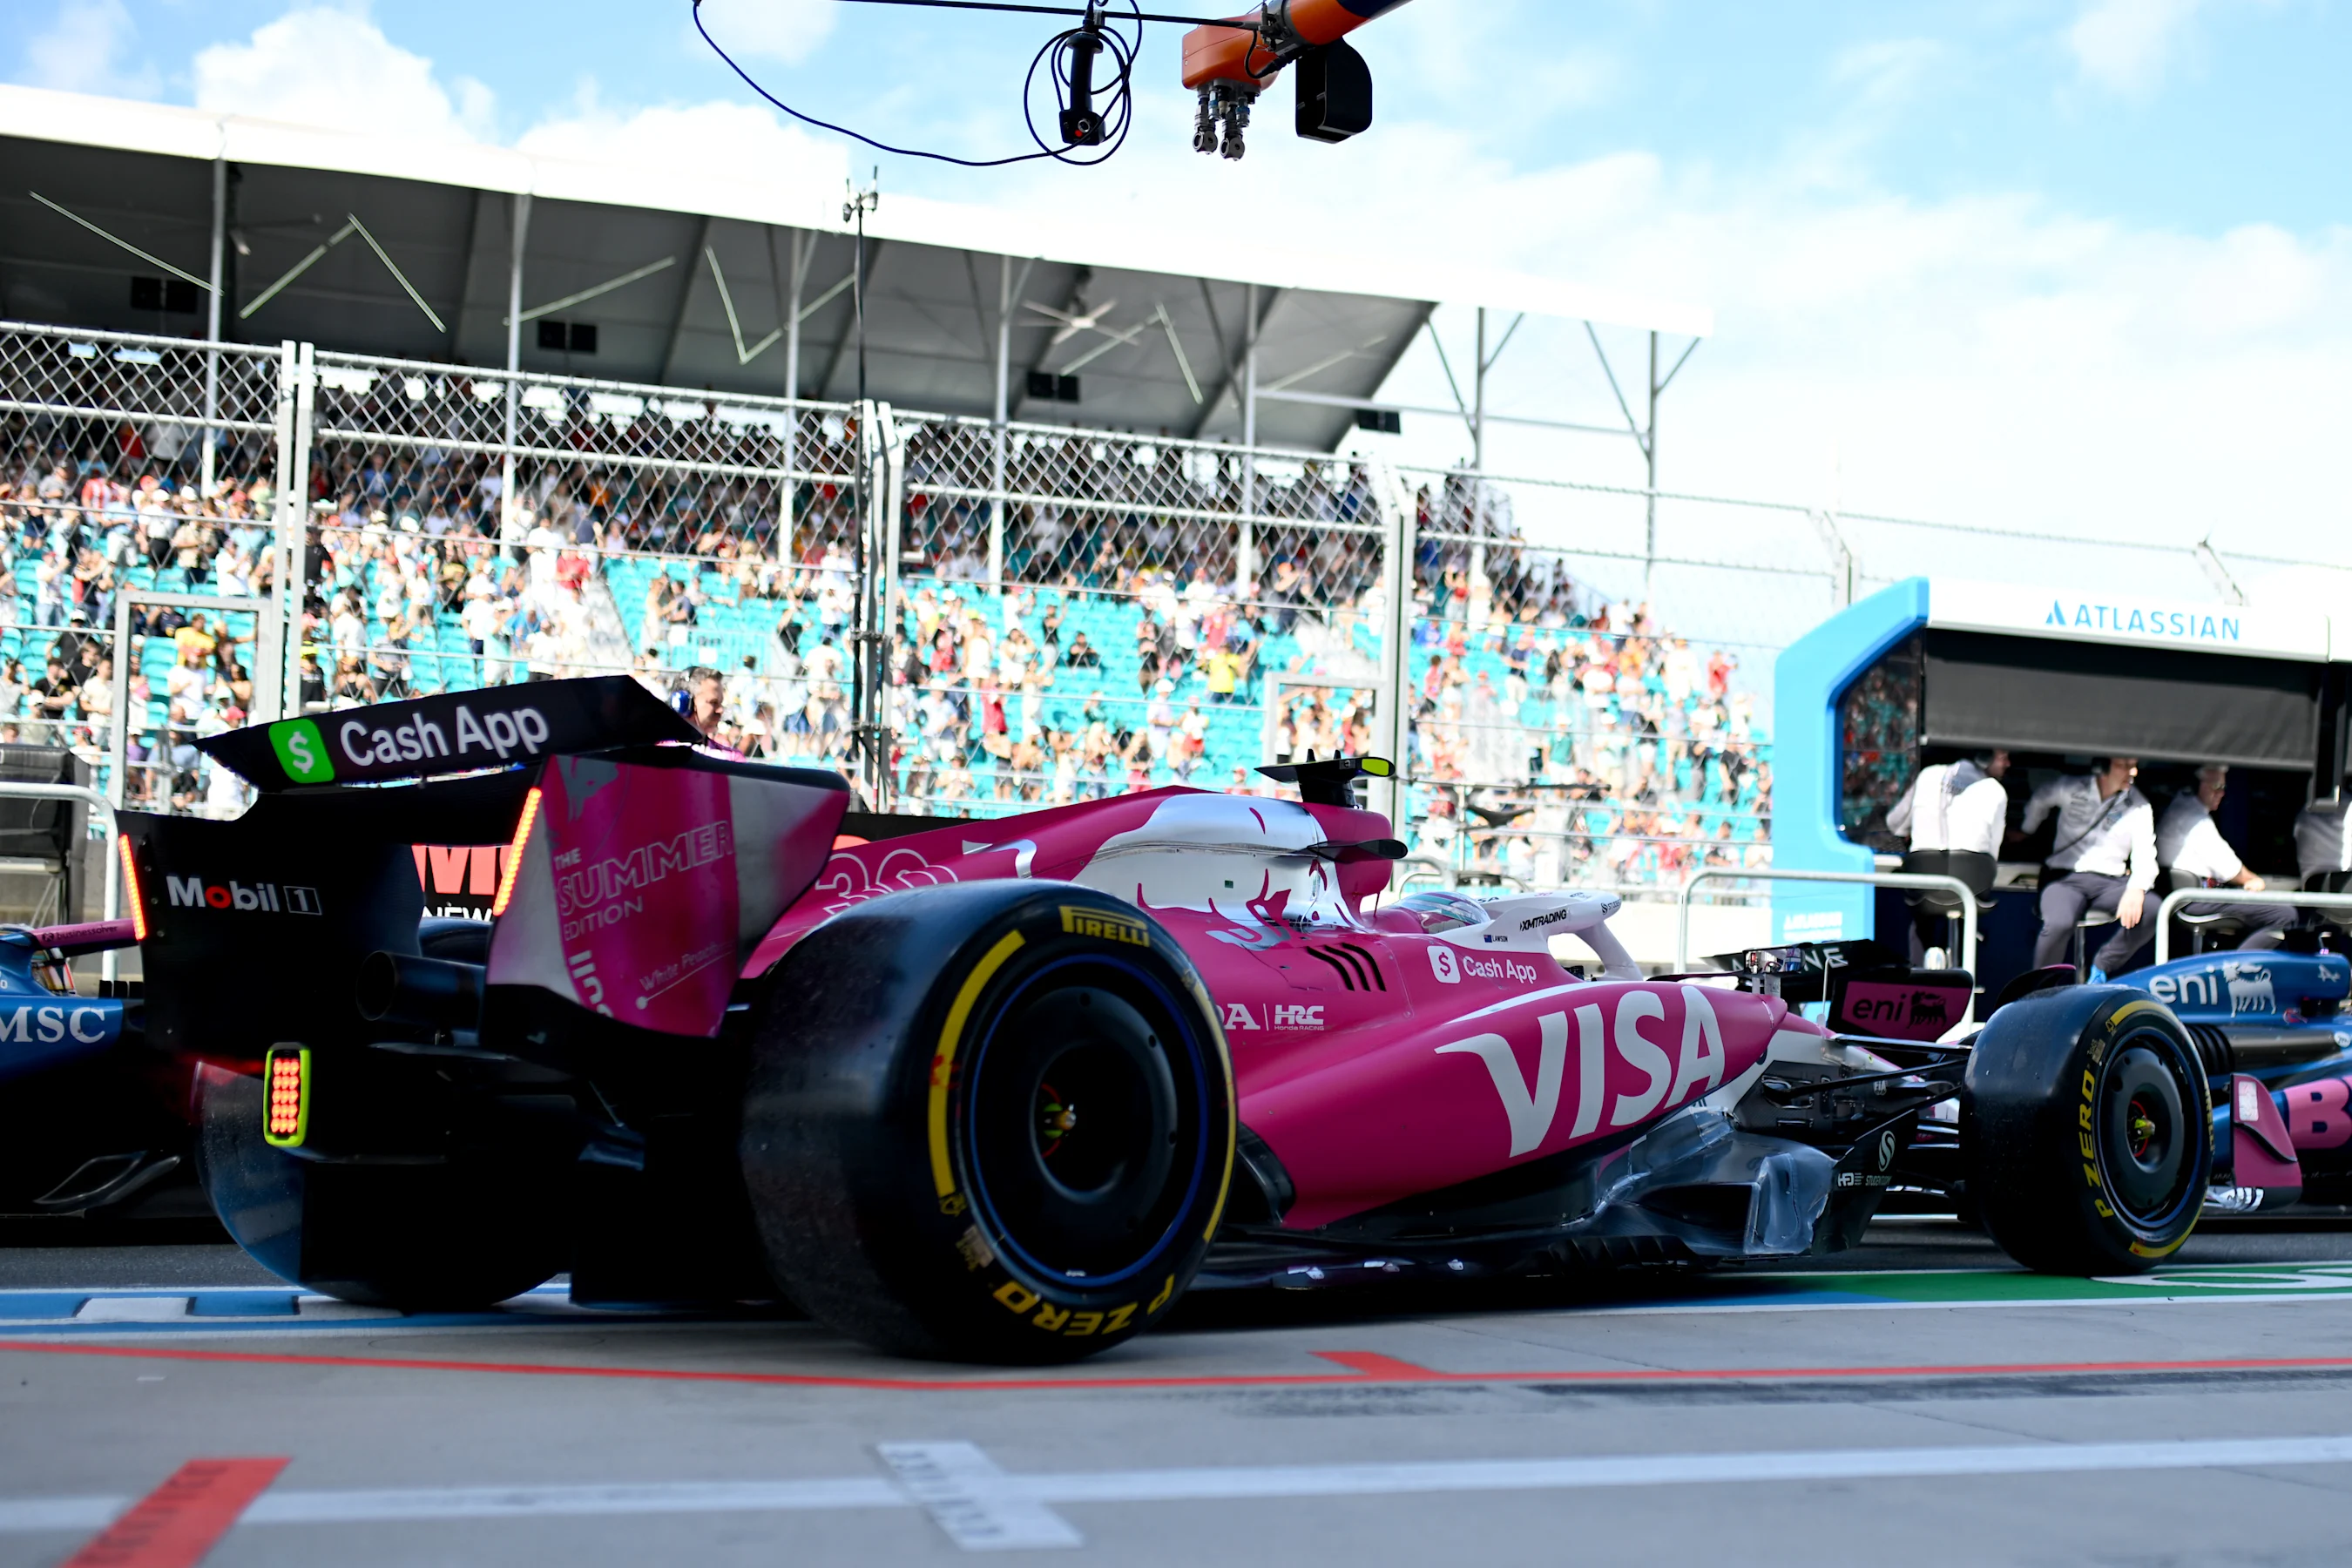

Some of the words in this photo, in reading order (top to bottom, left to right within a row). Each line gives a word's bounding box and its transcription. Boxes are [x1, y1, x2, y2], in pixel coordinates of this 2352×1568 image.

[2075, 605, 2239, 640] ATLASSIAN
[341, 713, 449, 767] Cash
[456, 706, 549, 759] App
[554, 848, 581, 870] THE
[557, 820, 735, 916] SUMMER
[166, 875, 280, 912] Mobil
[57, 924, 118, 941] businessolver
[564, 896, 643, 941] EDITION
[1058, 905, 1150, 948] PIRELLI
[1463, 956, 1504, 977] Cash
[1506, 959, 1537, 983] App
[2148, 965, 2219, 1004] eni
[0, 1006, 105, 1044] MSC
[1274, 1004, 1324, 1025] HRC
[1853, 994, 1906, 1022] eni
[1434, 985, 1726, 1159] VISA
[2079, 1070, 2101, 1187] ZERO
[2094, 1199, 2114, 1218] P
[993, 1281, 1139, 1336] ZERO
[1147, 1273, 1175, 1315] P
